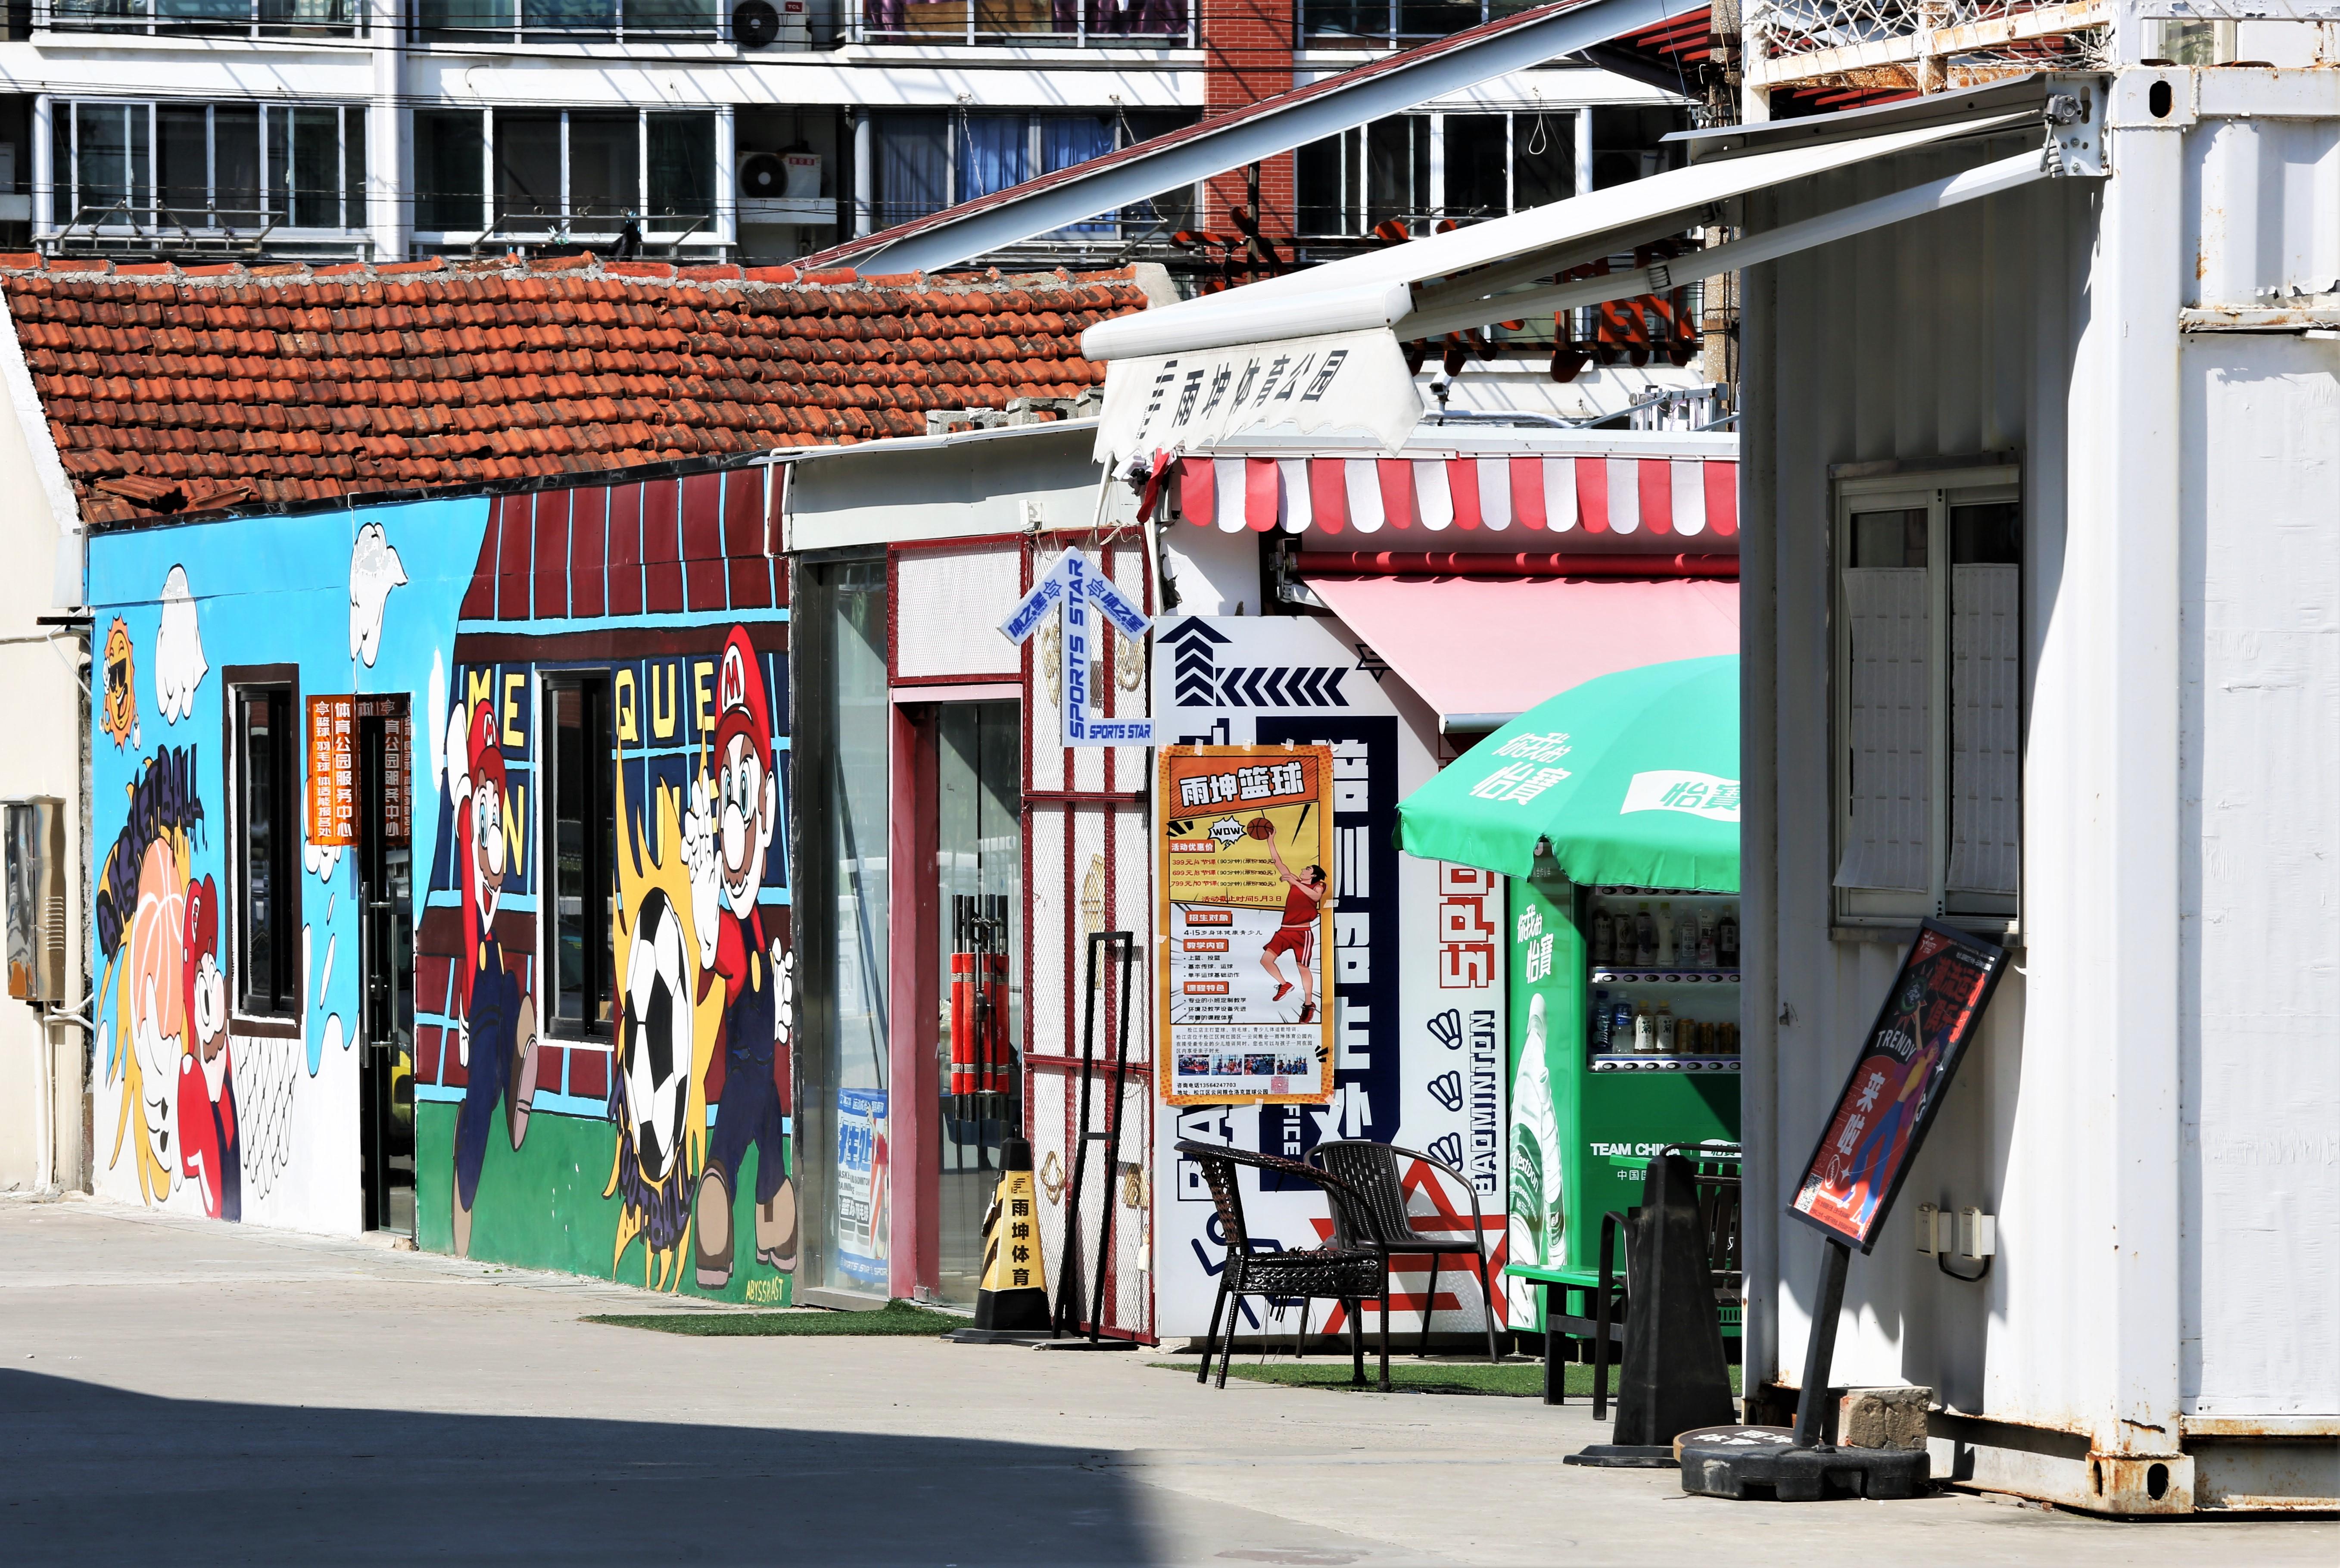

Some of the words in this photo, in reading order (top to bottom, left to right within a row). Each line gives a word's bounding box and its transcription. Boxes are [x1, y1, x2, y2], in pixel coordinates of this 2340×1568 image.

[1172, 350, 1349, 428] 雨坤体育公园
[1069, 558, 1083, 626] STAR
[1100, 592, 1145, 632] 体之星
[1008, 591, 1047, 638] 体之星
[1021, 617, 1038, 635] SPORTS
[1038, 604, 1048, 616] STAR
[1103, 605, 1121, 622] SPORTS
[1121, 622, 1133, 633] STAR
[1069, 634, 1084, 739] SPORTS
[316, 716, 330, 737] 篮球
[1090, 725, 1125, 739] SPORTS
[1128, 724, 1150, 738] STAR
[1491, 732, 1573, 764] 你我的
[317, 741, 330, 772] 羽毛球
[335, 701, 352, 837] 体育公园服务中心
[1179, 761, 1305, 807] 雨坤篮球
[317, 776, 331, 837] 体适能报名处
[96, 743, 205, 960] BASKETBALL
[1171, 843, 1213, 852] 活动优惠价
[1212, 826, 1240, 836] WOW
[1517, 903, 1543, 944] 你我的
[1876, 1030, 1917, 1062] TRENDY
[1470, 1010, 1496, 1196] BADMINTON
[1837, 1072, 1886, 1156] 来啦
[607, 1068, 698, 1254] FOOTBALL
[1590, 1143, 1632, 1156] TEAM
[1011, 1199, 1030, 1286] 雨坤体育
